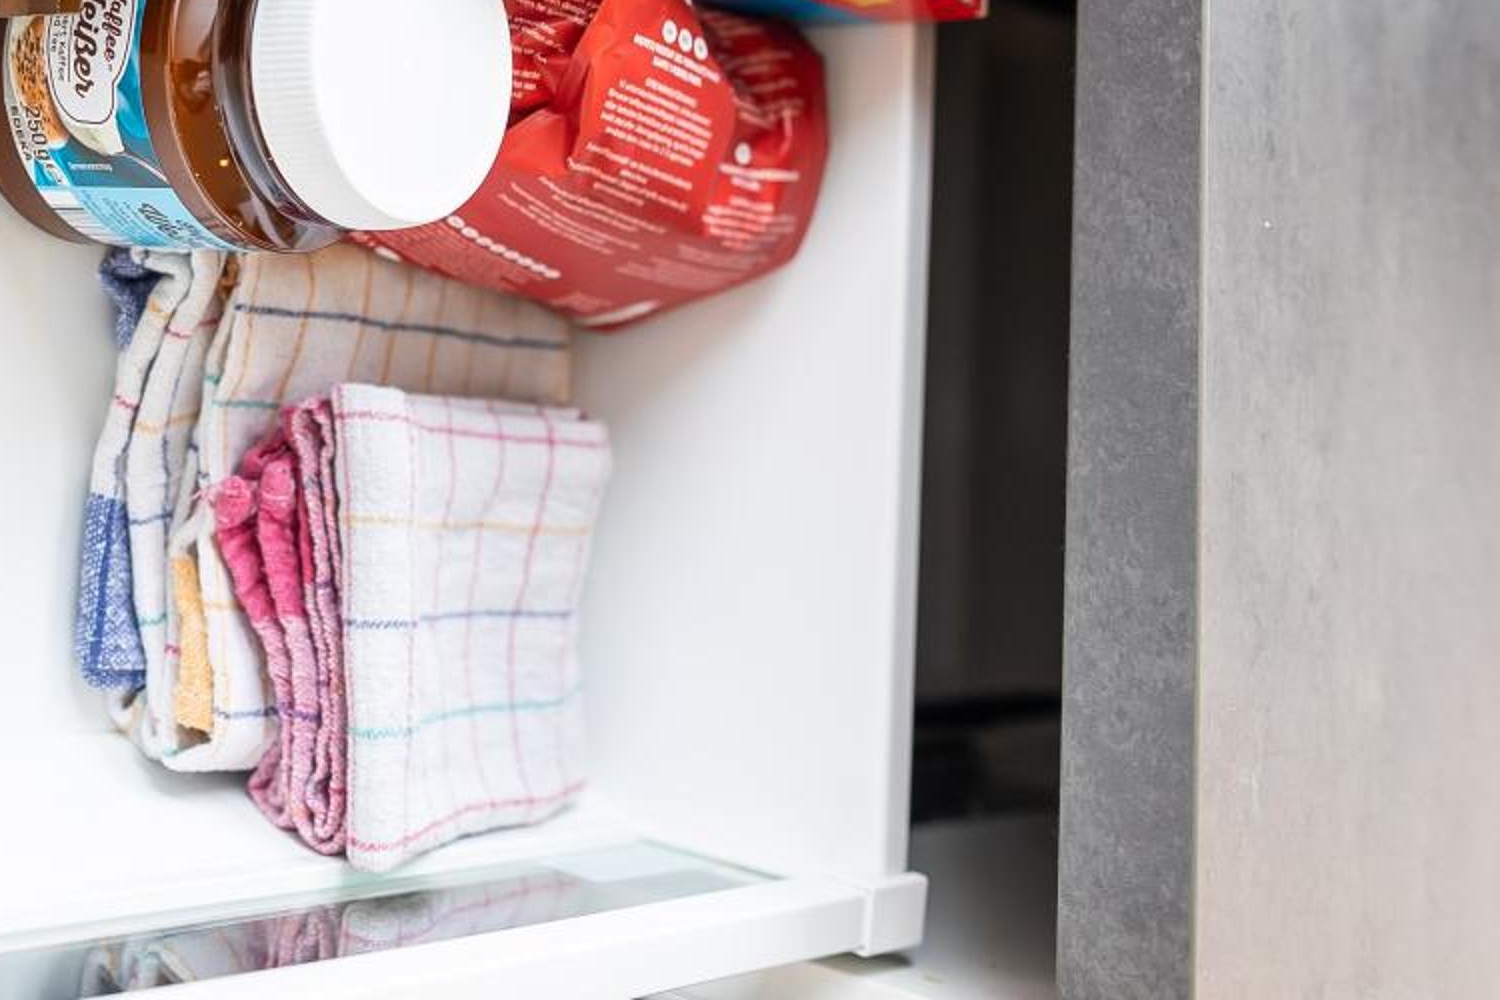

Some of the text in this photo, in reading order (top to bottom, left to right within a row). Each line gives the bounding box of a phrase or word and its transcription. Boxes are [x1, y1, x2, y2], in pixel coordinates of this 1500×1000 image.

[11, 104, 32, 162] EDEKA
[25, 105, 50, 164] 250 g
